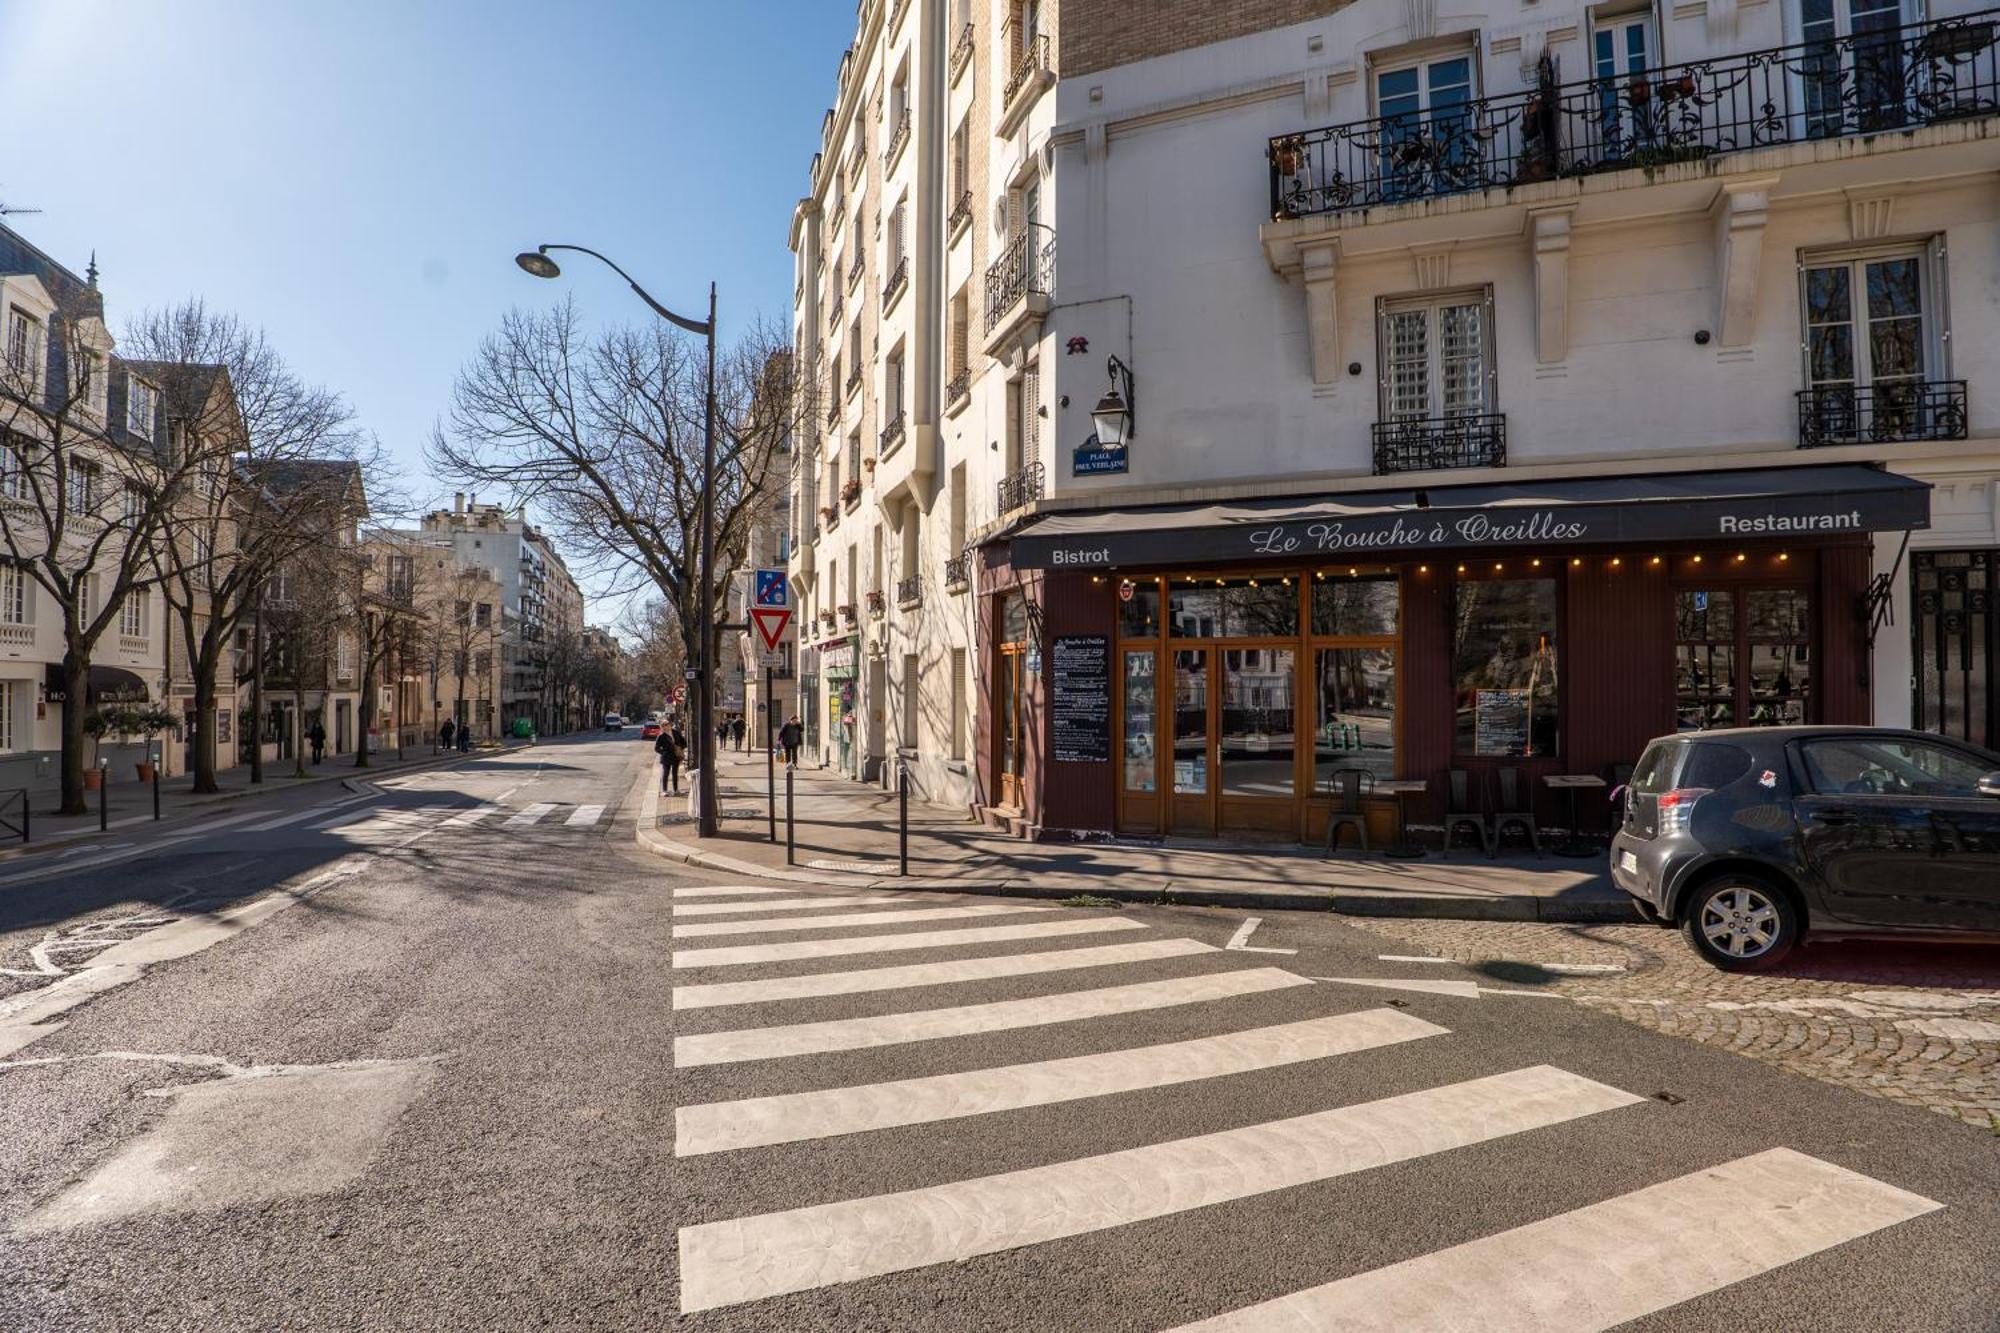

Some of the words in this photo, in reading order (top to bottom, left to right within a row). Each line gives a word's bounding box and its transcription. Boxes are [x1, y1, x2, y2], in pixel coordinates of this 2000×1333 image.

[1249, 527, 1300, 553] Le
[1307, 519, 1425, 550] Bouche
[1429, 522, 1449, 543] à
[1455, 512, 1587, 542] Oreilles
[1719, 510, 1862, 533] Restaurant
[1052, 548, 1110, 565] Bistrot
